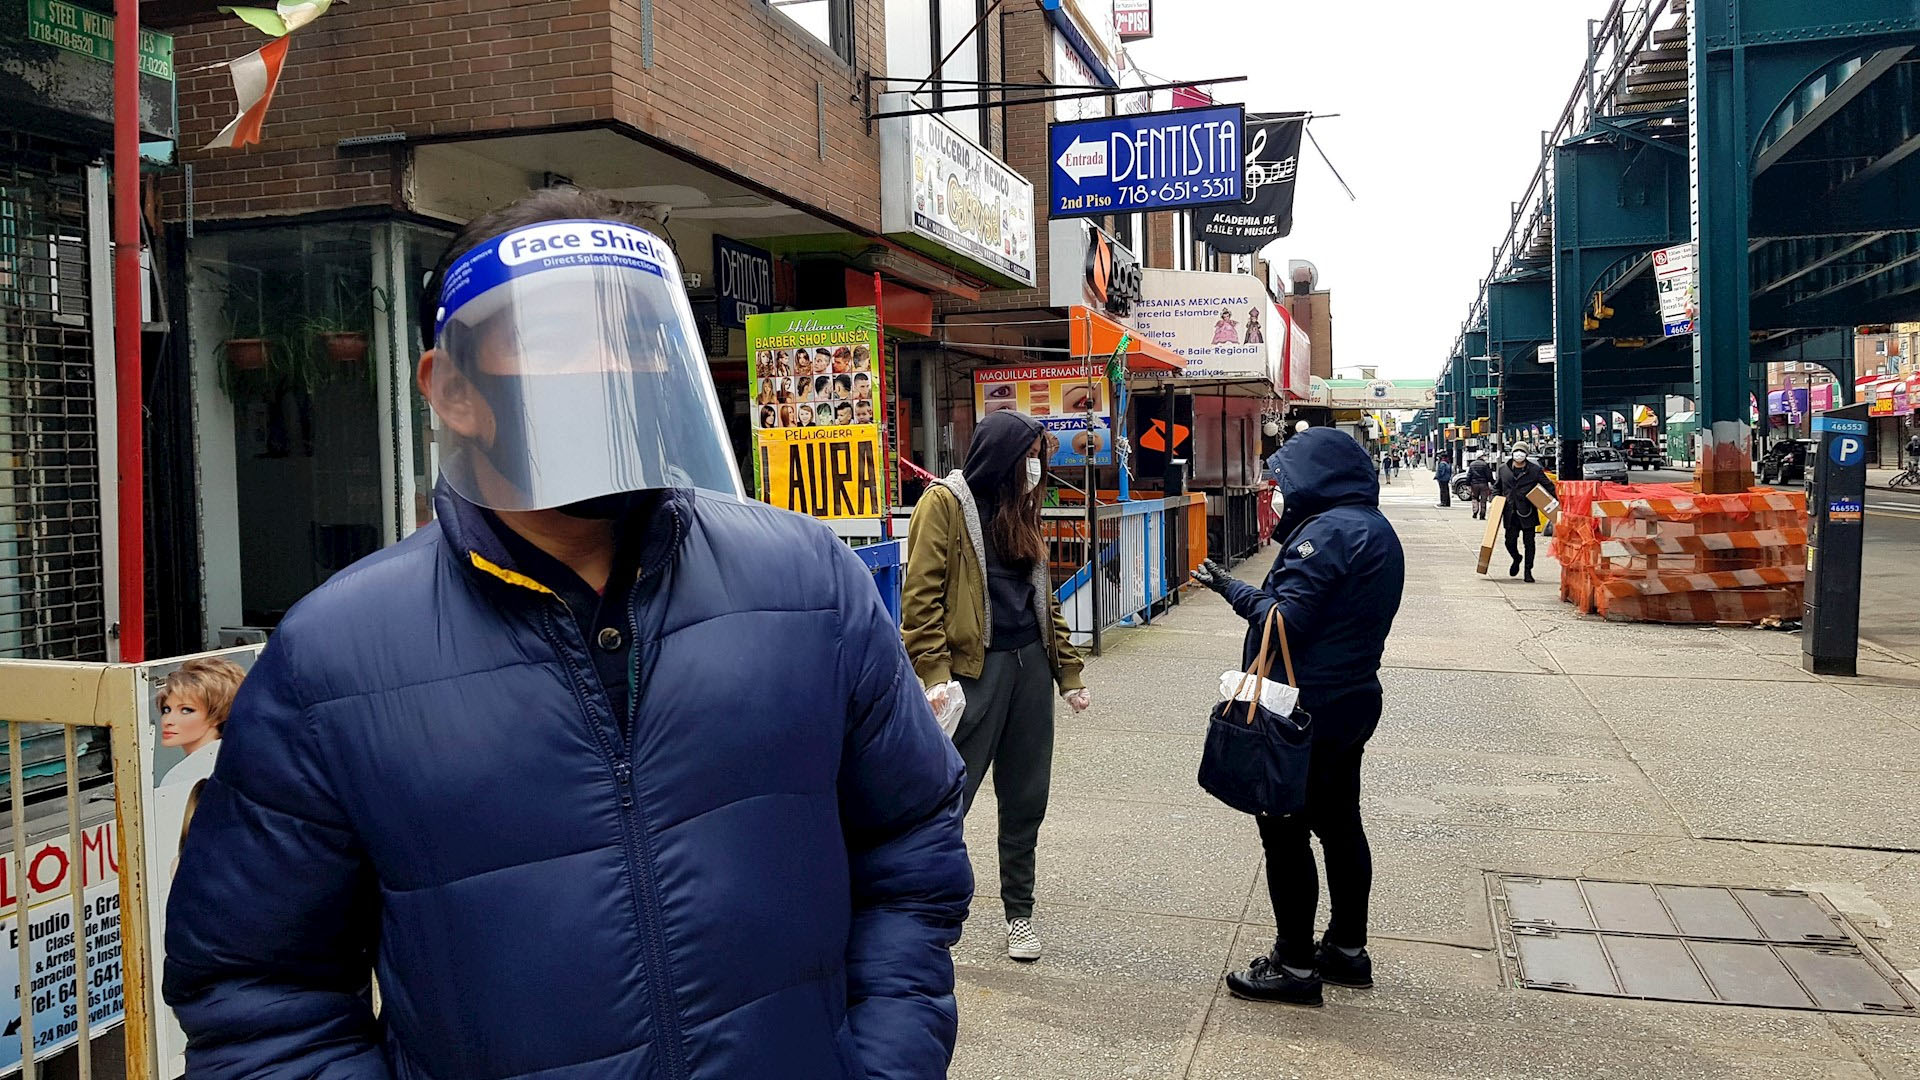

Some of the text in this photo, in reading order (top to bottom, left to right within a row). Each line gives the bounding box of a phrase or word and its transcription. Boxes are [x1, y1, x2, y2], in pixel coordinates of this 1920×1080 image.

[49, 1, 77, 29] STEEL
[1128, 12, 1149, 32] PISO
[33, 21, 93, 54] 718-478-6520
[929, 122, 970, 170] DULCERIA
[1111, 120, 1236, 183] DENTISTA
[1065, 152, 1104, 167] Entrada
[984, 162, 1009, 198] MEXICO
[1061, 193, 1112, 210] 2nd Piso
[1205, 223, 1234, 235] BAILE
[1236, 226, 1242, 236] Y
[1213, 213, 1276, 226] ACADEMIA DE
[511, 230, 668, 265] Face Shield
[543, 252, 658, 272] Direct Splash Protection
[721, 247, 770, 306] DENTISTA
[1662, 280, 1670, 292] 2
[1188, 296, 1249, 306] MEXICANAS
[1174, 309, 1219, 317] Estambre
[779, 319, 844, 334] Hildaura
[1671, 324, 1689, 334] 4665
[755, 329, 870, 349] BARBER SHOP UNISEX
[1188, 347, 1211, 355] Baile
[1214, 346, 1258, 356] Regional
[979, 368, 1038, 381] MAQUILLAJE
[1831, 423, 1862, 431] 466553
[1840, 438, 1859, 462] P
[10, 912, 70, 949] Etudio
[46, 931, 76, 953] Clase
[36, 961, 43, 974] &
[46, 940, 92, 970] Arregs
[15, 963, 76, 999] Rparacio
[59, 961, 123, 1003] 64-641-
[56, 1003, 110, 1039] Roovelt
